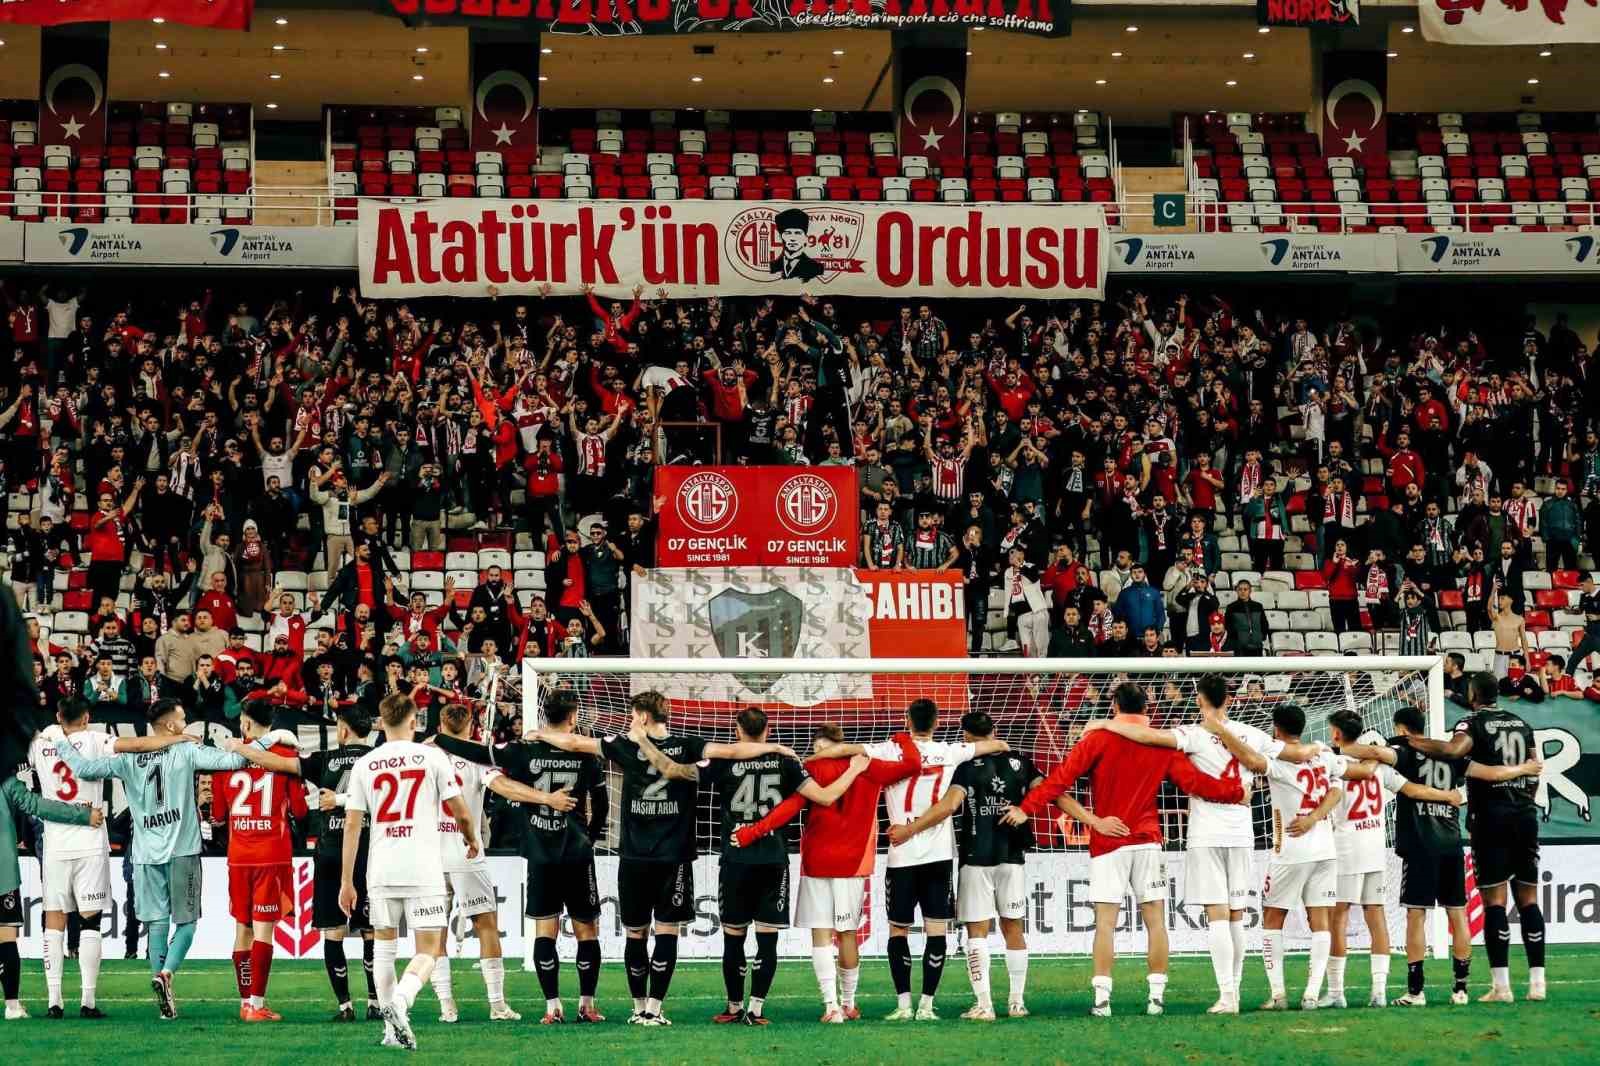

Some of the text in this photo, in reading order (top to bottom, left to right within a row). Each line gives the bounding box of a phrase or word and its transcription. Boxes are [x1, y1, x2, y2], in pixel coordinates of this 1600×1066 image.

[796, 12, 1053, 32] Credimi non importa ciò che soffriamo
[1162, 200, 1176, 219] C
[91, 241, 142, 250] ANTALYA
[242, 242, 292, 251] ANTALYA
[373, 204, 1098, 289] Atatürk'ün Ordusu
[1452, 248, 1500, 256] ANTALYA
[242, 252, 270, 260] Airport
[1146, 250, 1195, 259] ANTALYA
[1292, 250, 1341, 260] ANTALYA
[1146, 260, 1174, 270] Airport
[1292, 260, 1320, 270] Airport
[681, 474, 734, 496] ANTALYASPOR
[780, 476, 832, 500] ANTALYASPOR
[668, 534, 748, 552] 07 GENÇLİK
[768, 536, 847, 556] 07 GENÇLİK
[687, 554, 711, 562] SINCE
[369, 756, 406, 770] anex
[536, 759, 582, 768] AUTOPORT
[53, 760, 78, 801] 3
[146, 764, 165, 808] 1
[1296, 767, 1329, 808] 25
[230, 770, 274, 816] 21
[374, 770, 426, 822] 27
[730, 774, 783, 820] 45
[1346, 776, 1382, 820] 29
[658, 800, 679, 815] ARDA
[386, 826, 413, 838] MERT
[420, 906, 444, 916] PASHA
